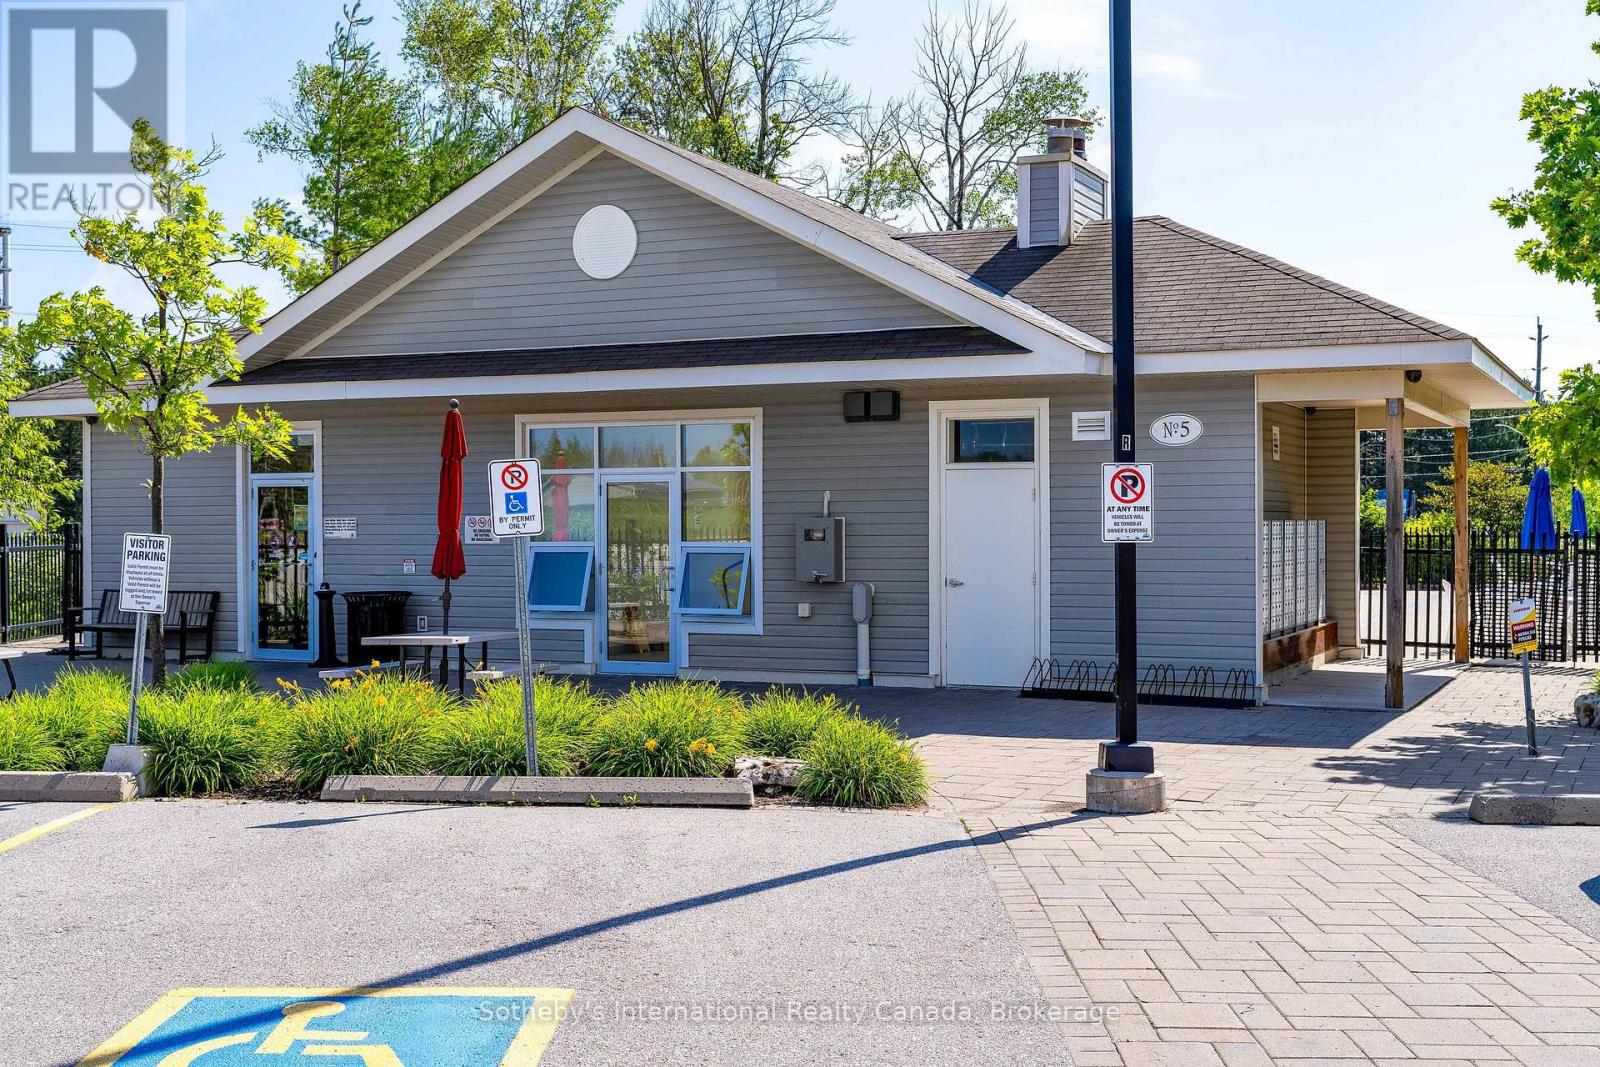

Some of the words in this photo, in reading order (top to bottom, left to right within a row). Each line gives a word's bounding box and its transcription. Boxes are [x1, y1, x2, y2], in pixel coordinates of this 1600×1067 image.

[499, 516, 509, 524] BY
[511, 514, 535, 523] PERMIT
[130, 538, 165, 550] VISITOR
[127, 550, 166, 561] PARKING
